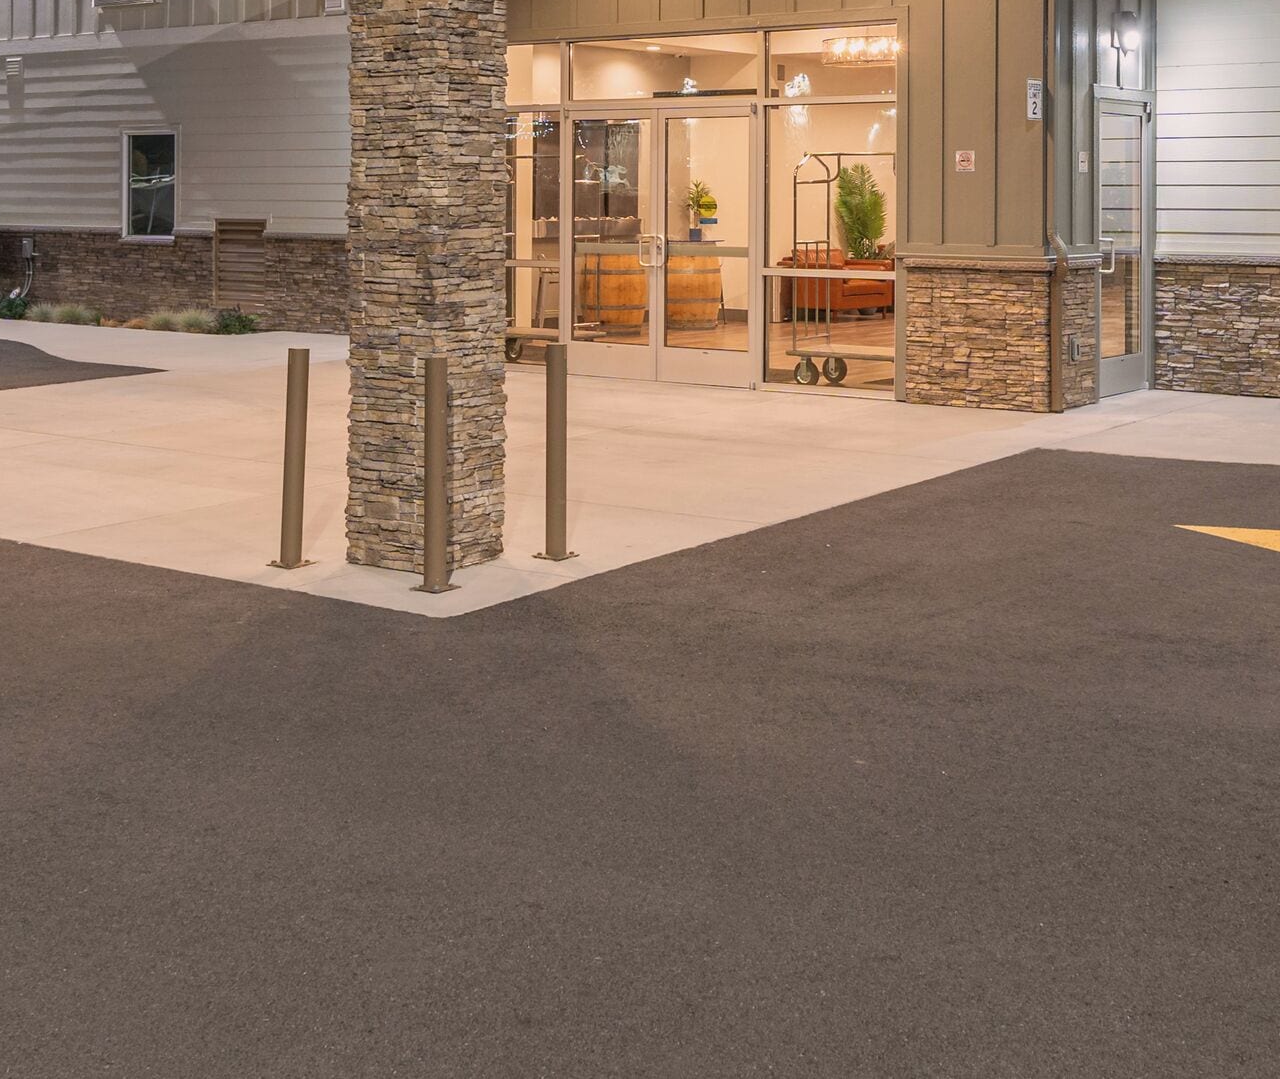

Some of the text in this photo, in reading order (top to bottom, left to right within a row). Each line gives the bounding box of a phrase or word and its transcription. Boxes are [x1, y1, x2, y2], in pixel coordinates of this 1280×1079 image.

[1028, 82, 1041, 91] SPEED
[1029, 91, 1040, 99] LIMIT
[1032, 101, 1038, 115] 2
